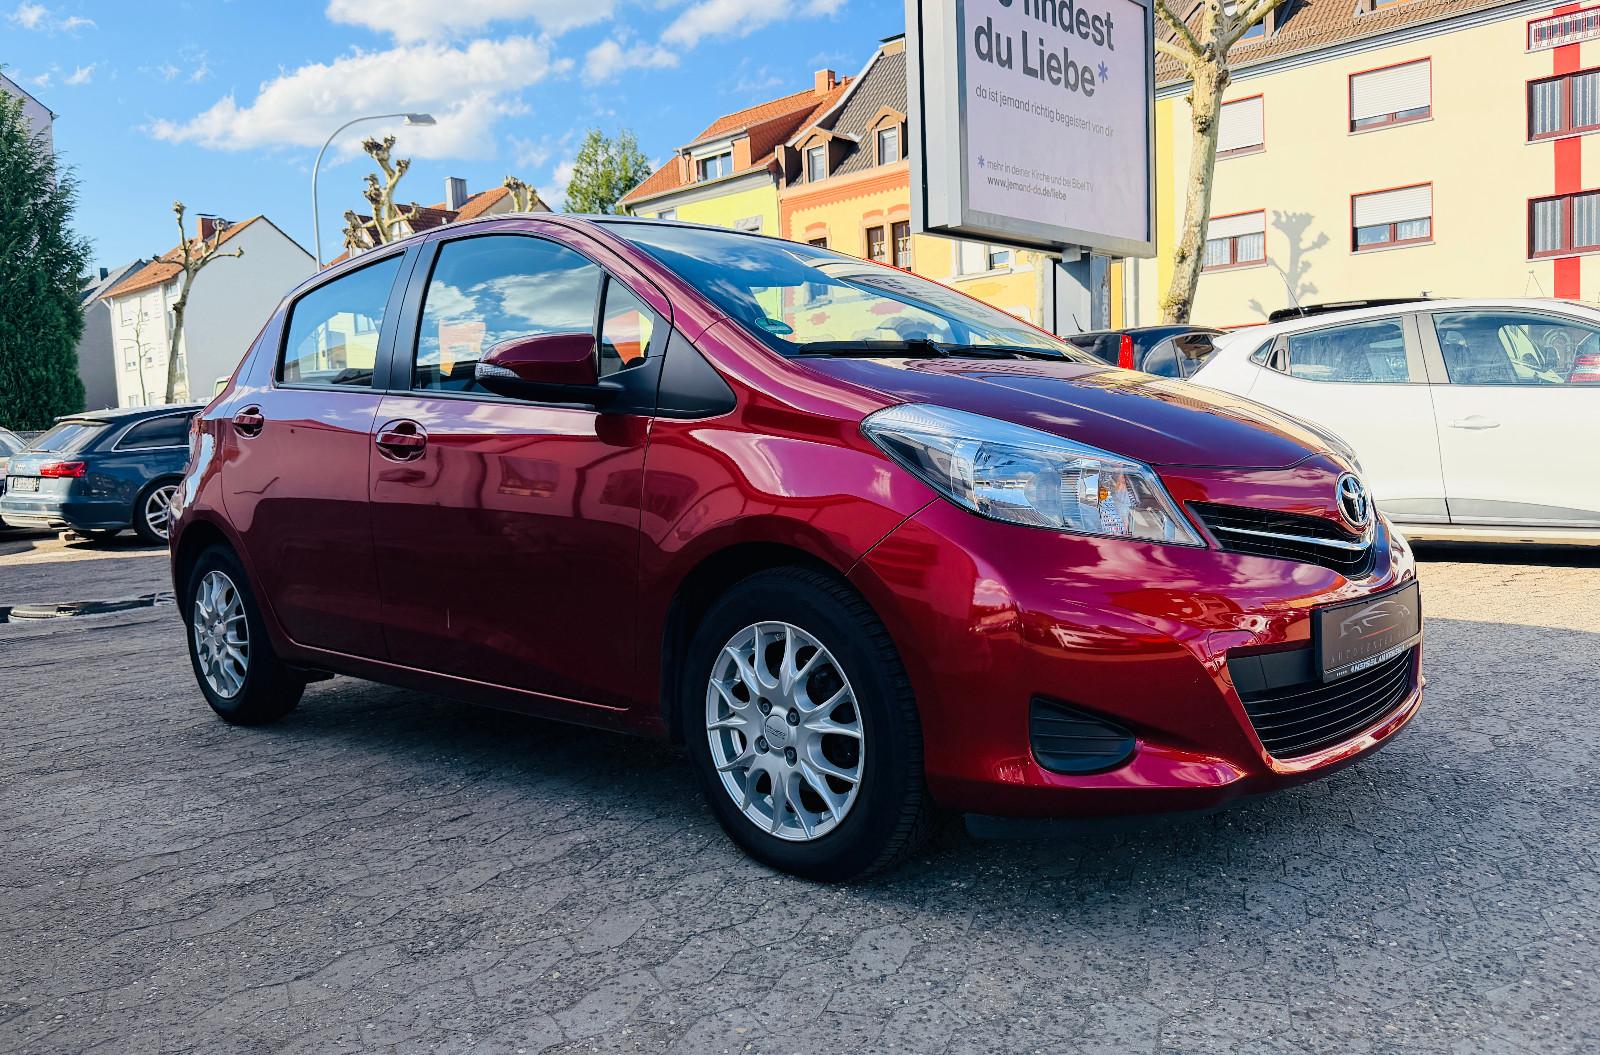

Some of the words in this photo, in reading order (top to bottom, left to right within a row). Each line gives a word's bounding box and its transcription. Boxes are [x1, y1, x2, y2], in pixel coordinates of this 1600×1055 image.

[974, 17, 1013, 70] du
[975, 84, 987, 99] da
[988, 88, 999, 103] ist
[999, 91, 1030, 112] jemand
[1031, 102, 1055, 123] richtig
[1055, 108, 1091, 133] begeistert
[1091, 123, 1104, 135] von
[1104, 126, 1114, 138] dir
[987, 160, 1004, 171] mehr
[1004, 162, 1011, 173] in
[1031, 169, 1051, 183] Kirche
[1051, 175, 1062, 185] und
[1062, 176, 1072, 187] bei
[1072, 178, 1086, 191] Bibel
[1086, 181, 1094, 192] TV
